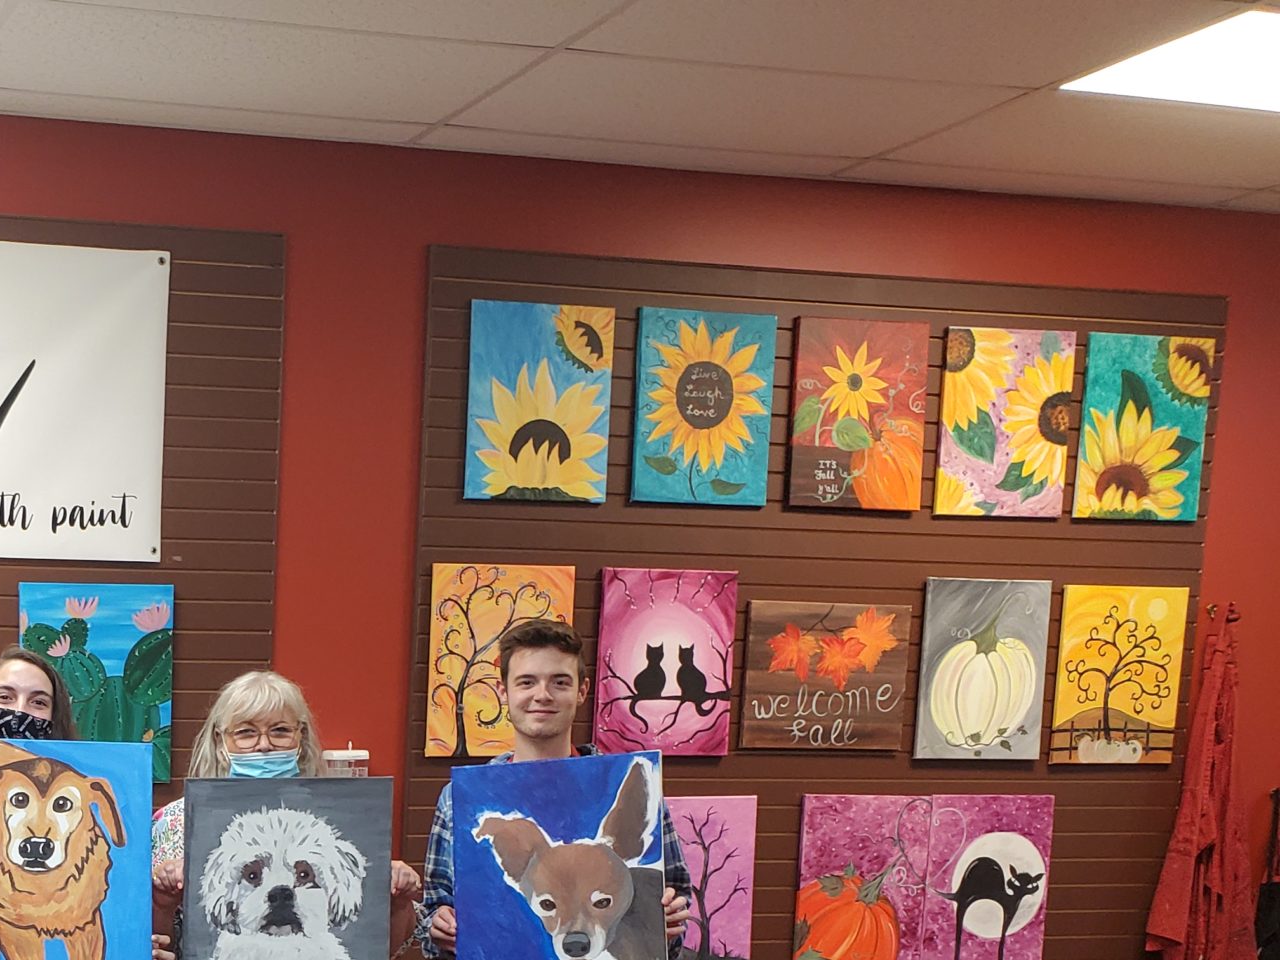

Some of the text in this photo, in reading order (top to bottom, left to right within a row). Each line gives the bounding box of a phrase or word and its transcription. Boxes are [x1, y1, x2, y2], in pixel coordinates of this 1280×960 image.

[684, 384, 725, 406] Laugh
[686, 404, 717, 418] Love
[51, 492, 138, 534] paint
